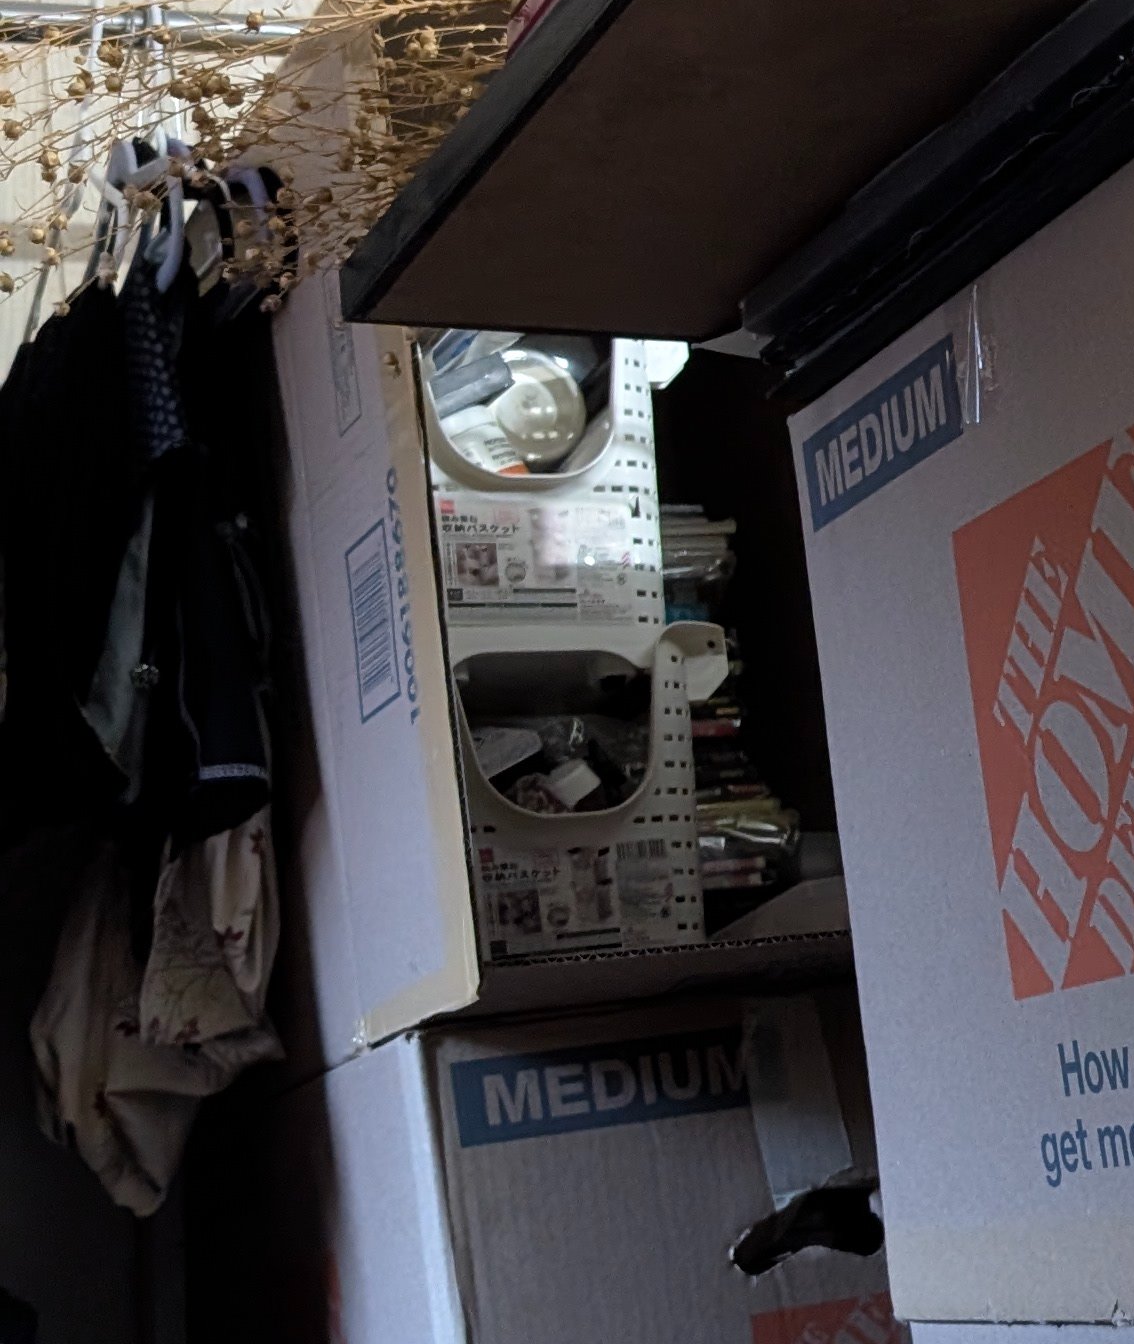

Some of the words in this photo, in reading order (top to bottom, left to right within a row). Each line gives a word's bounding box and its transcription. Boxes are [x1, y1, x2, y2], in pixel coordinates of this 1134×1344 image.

[815, 363, 947, 507] MEDIUM
[991, 535, 1070, 746] THE
[483, 1045, 748, 1127] MEDIUM
[1056, 1039, 1130, 1097] How
[1040, 1124, 1091, 1187] get
